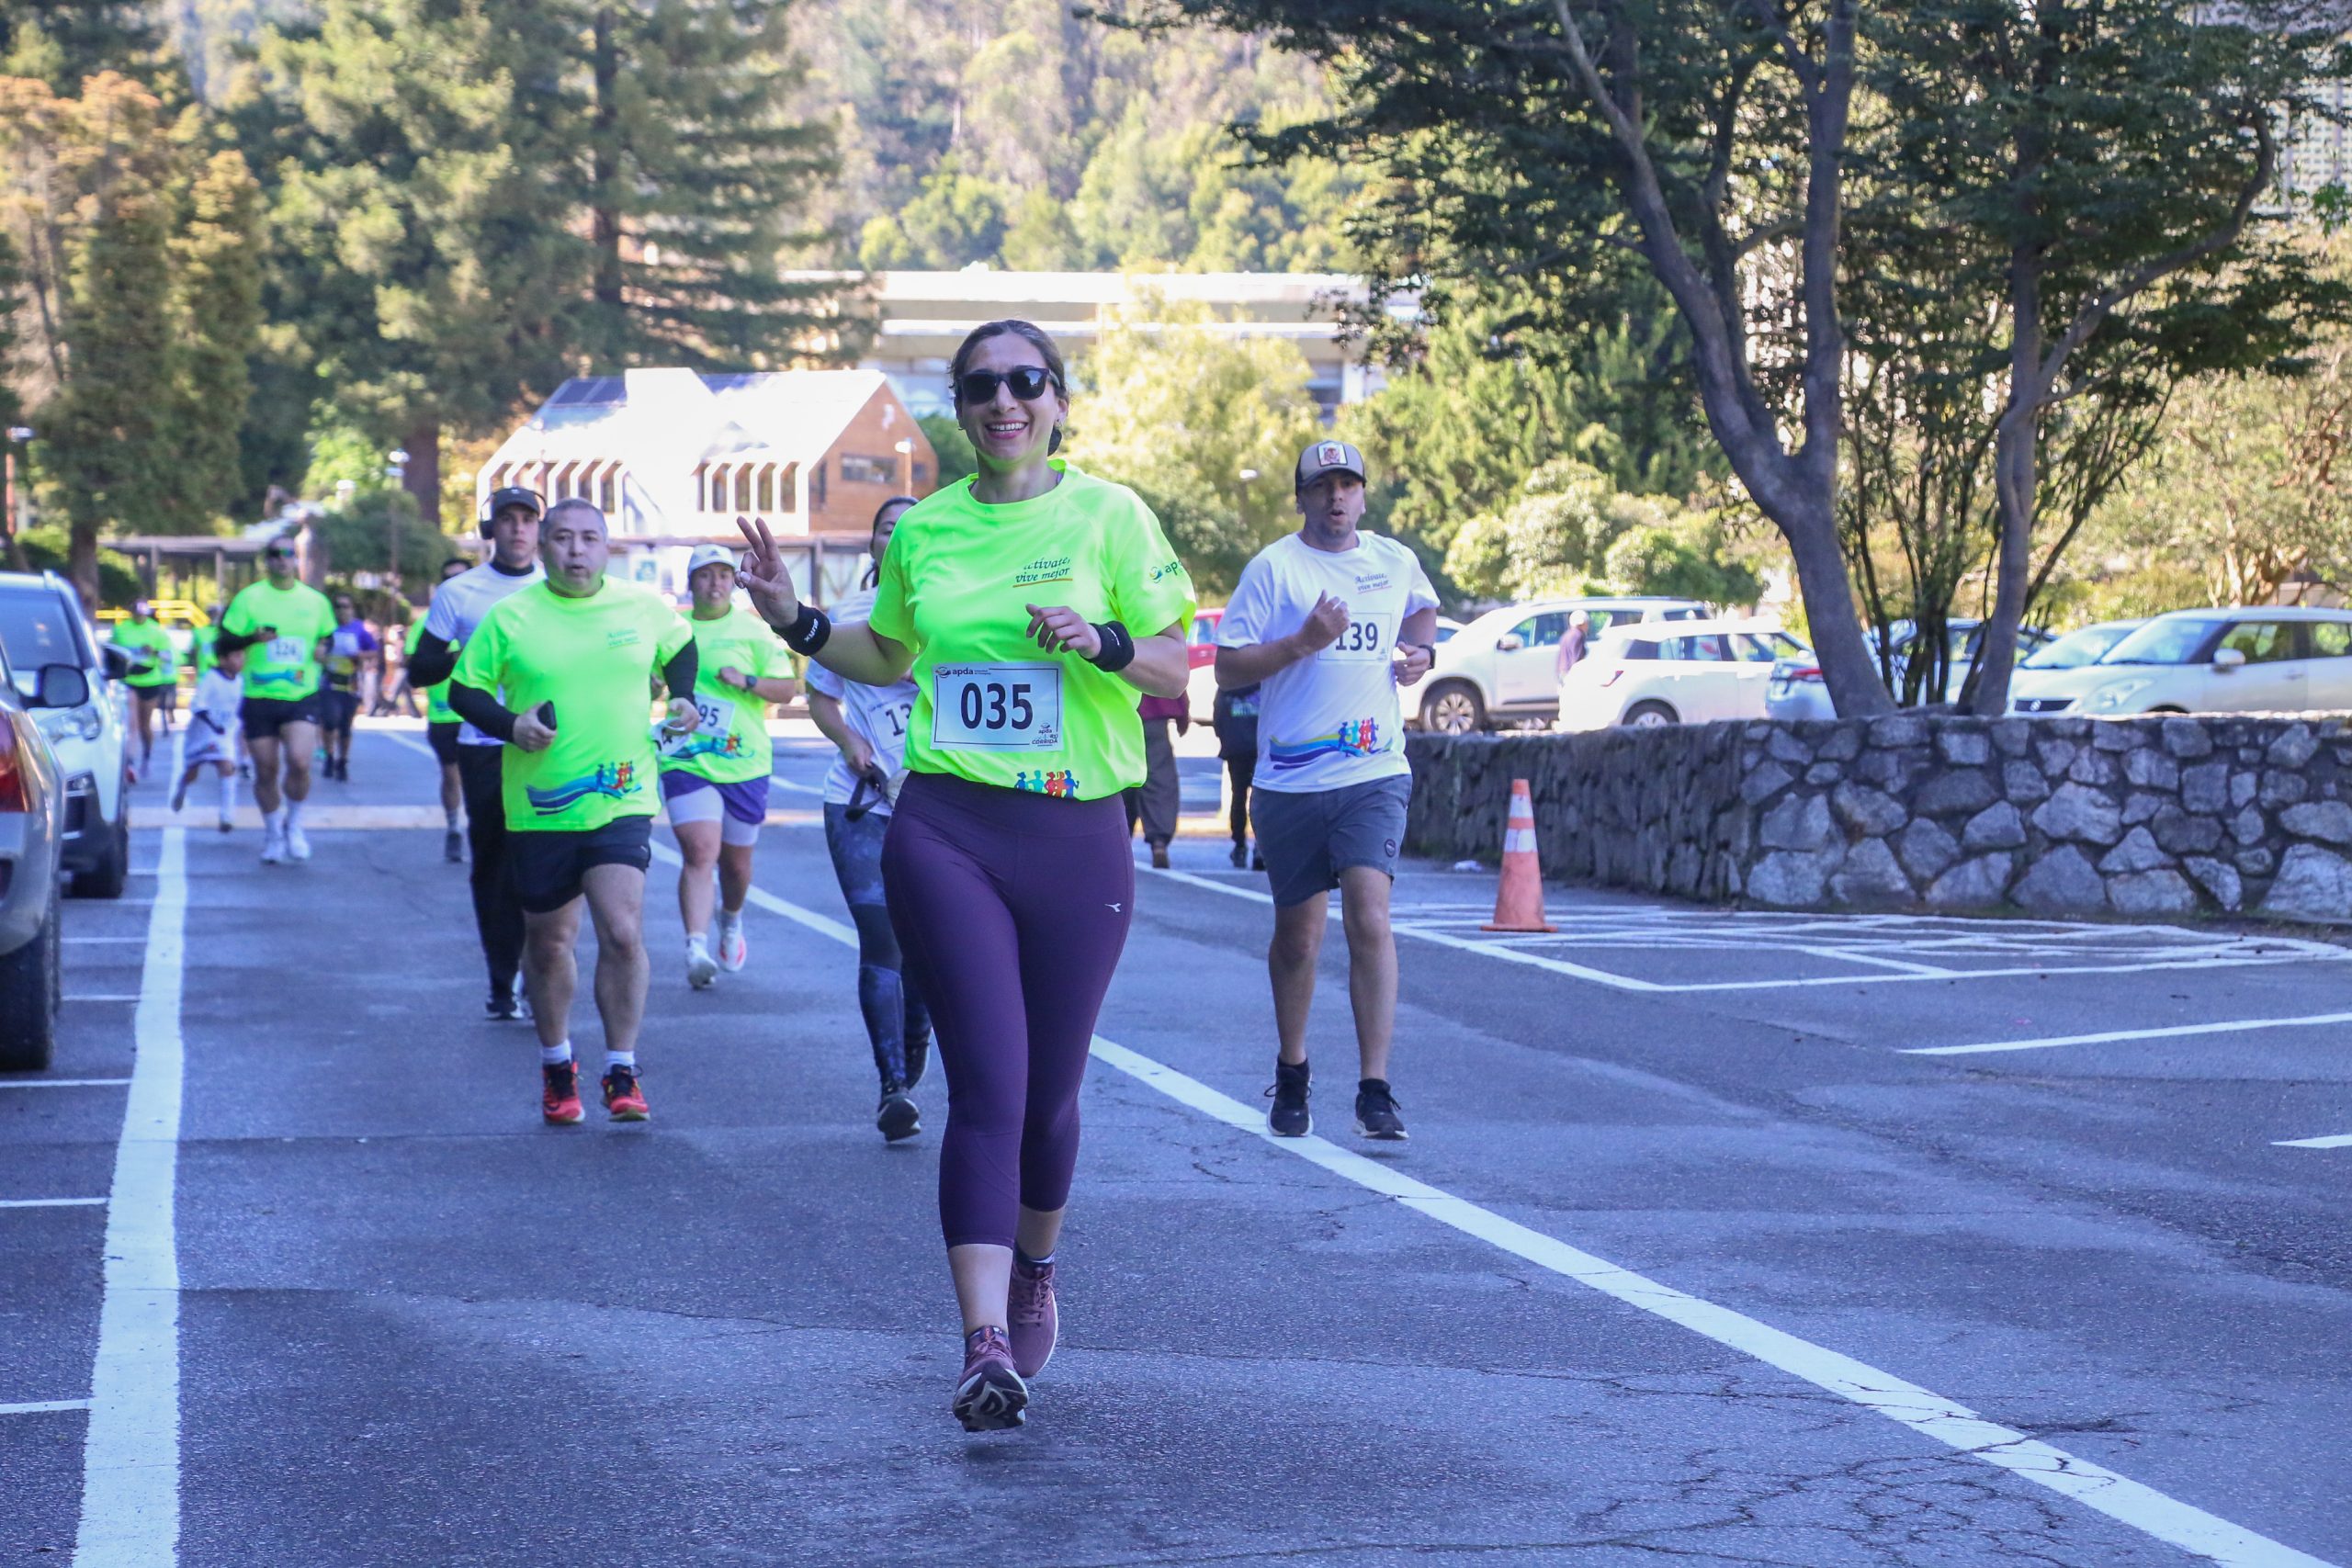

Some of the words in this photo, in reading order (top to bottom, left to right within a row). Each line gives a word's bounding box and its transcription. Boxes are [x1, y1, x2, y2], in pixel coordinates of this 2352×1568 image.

[1015, 571, 1038, 583] vive
[1041, 568, 1070, 581] mejor
[1335, 622, 1378, 651] 139
[952, 666, 974, 677] apda
[961, 682, 1033, 730] 035
